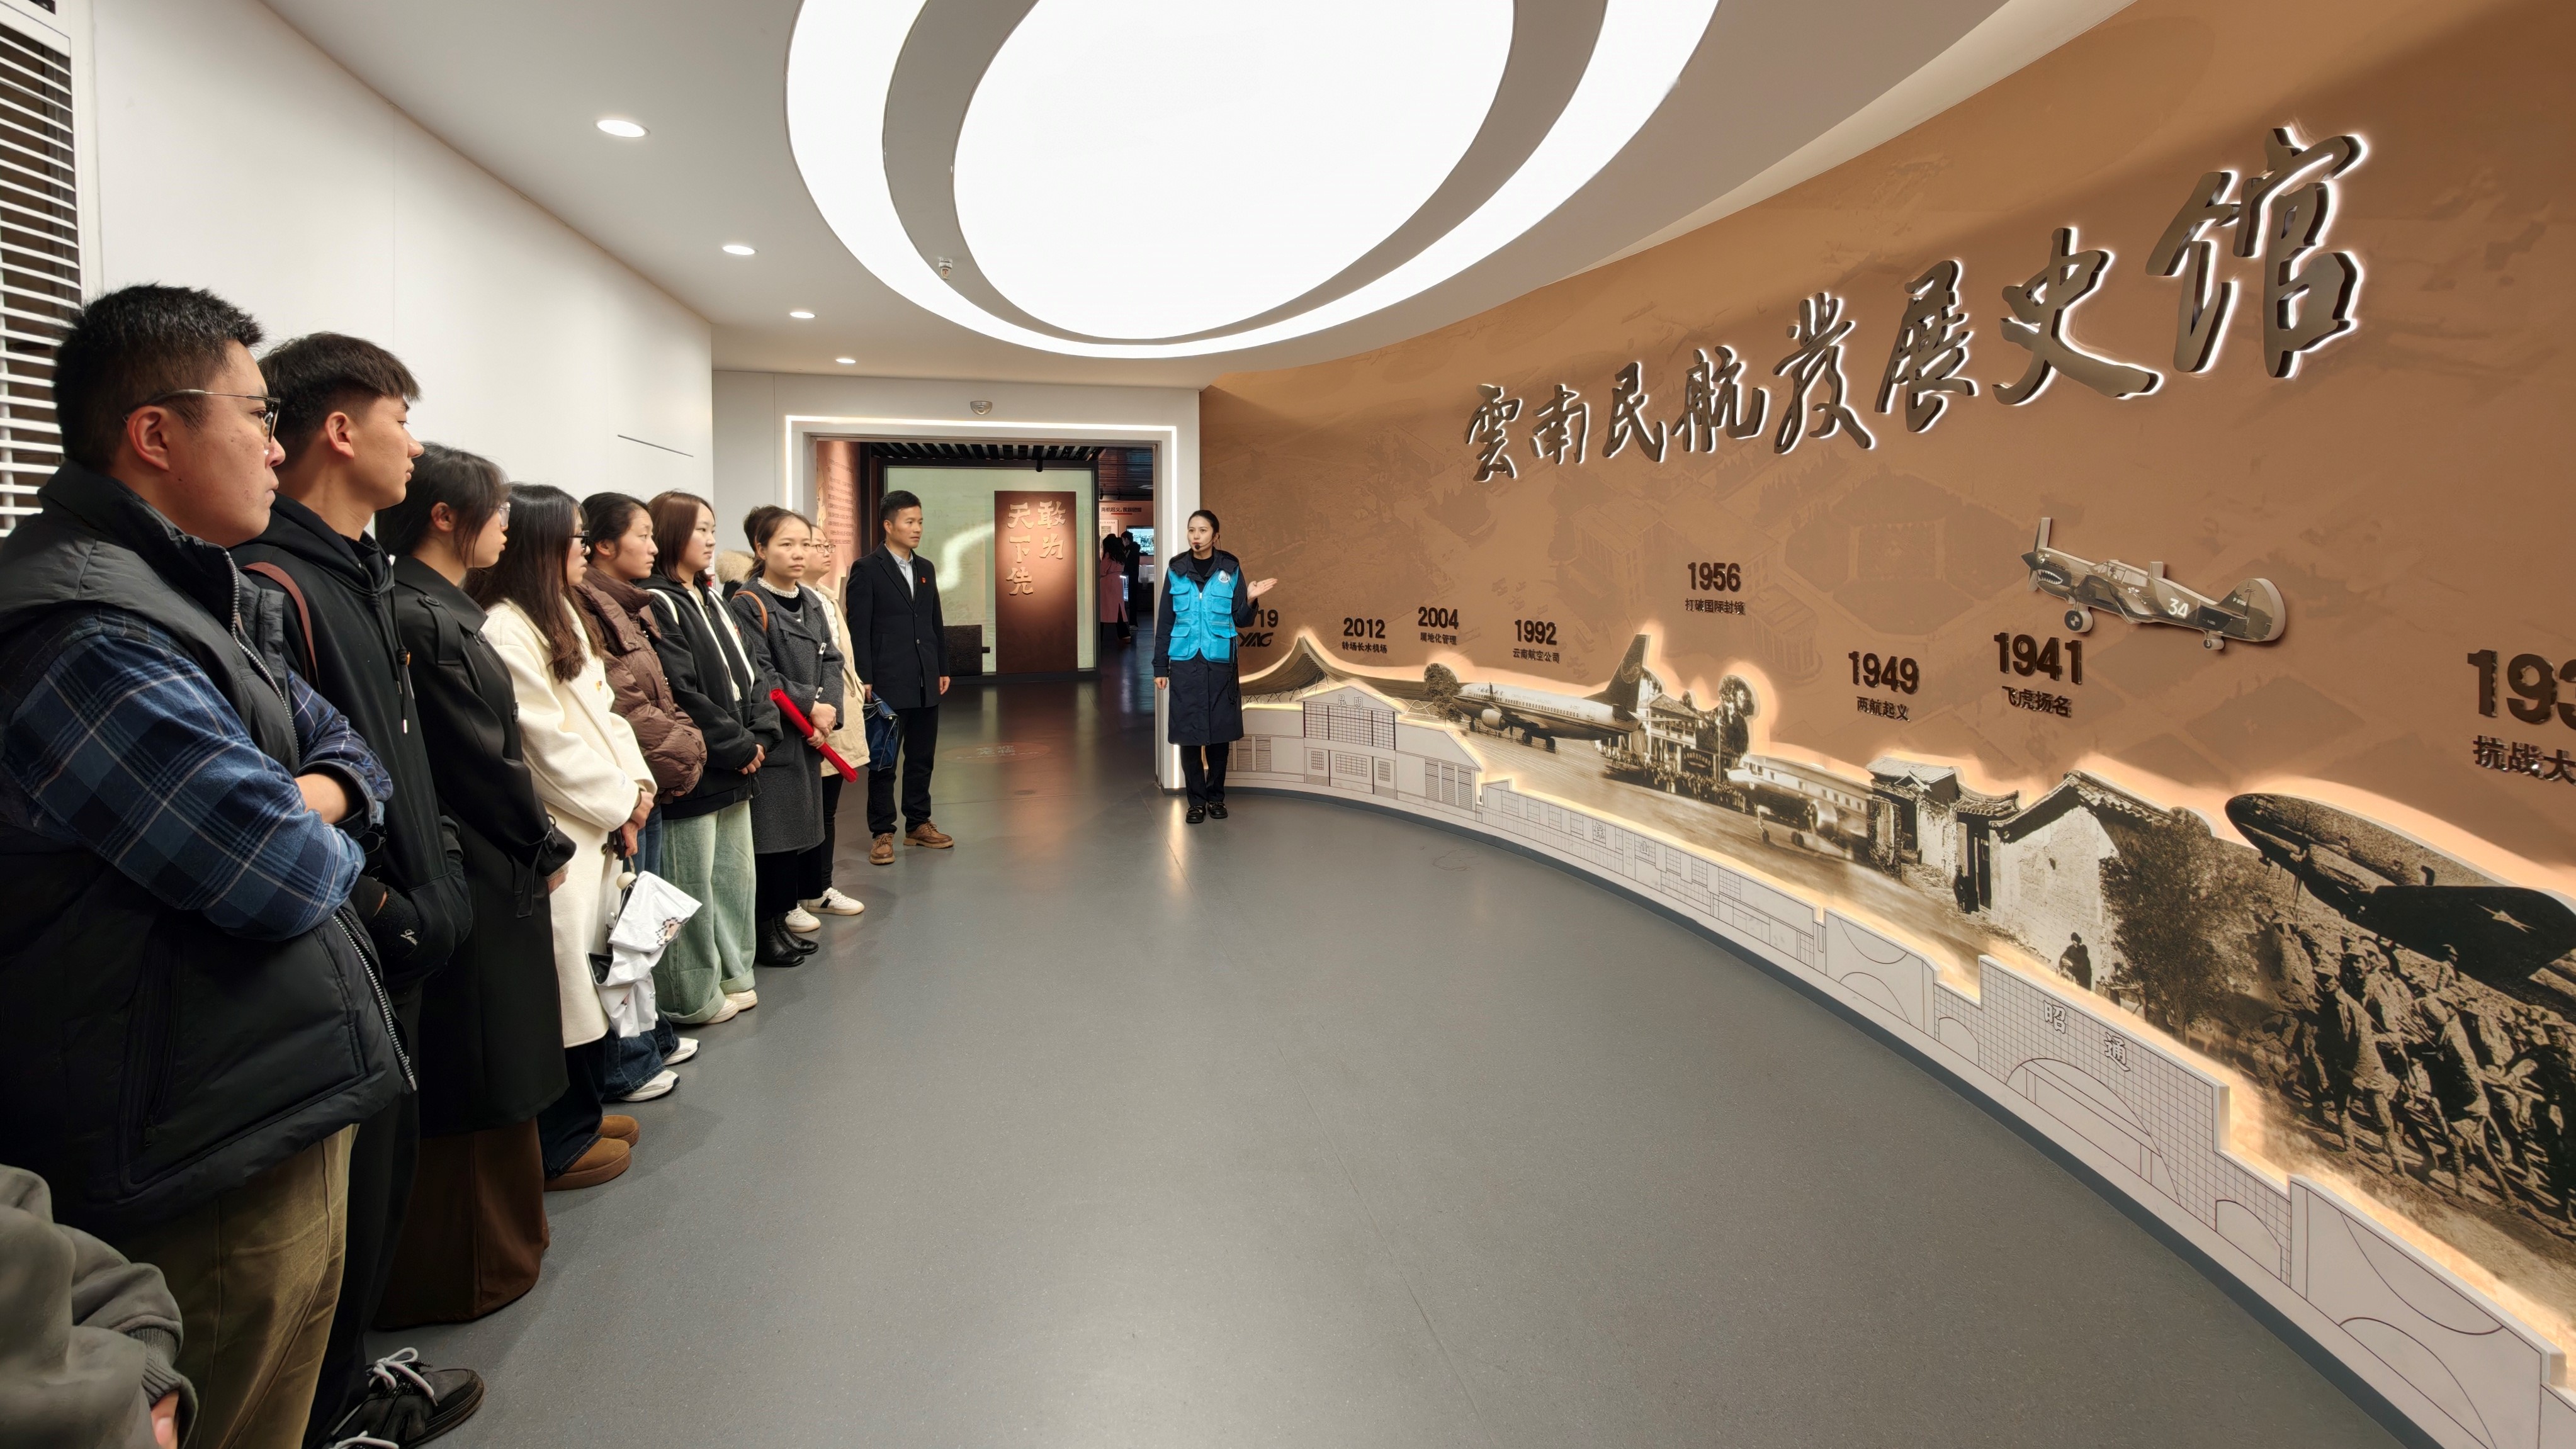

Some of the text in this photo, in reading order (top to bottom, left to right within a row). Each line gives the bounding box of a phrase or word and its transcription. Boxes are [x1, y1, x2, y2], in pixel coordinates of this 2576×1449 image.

[1037, 500, 1066, 560] 敢为
[1006, 502, 1034, 595] 天下先
[1688, 562, 1741, 592] 1956
[1257, 609, 1279, 628] 19
[1418, 606, 1459, 629] 2004
[1685, 598, 1746, 616] 打破国际封锁
[2168, 597, 2189, 619] 34
[1343, 617, 1386, 639] 2012
[1420, 632, 1457, 646] 属地化管理
[1515, 619, 1557, 645] 1992
[1342, 641, 1387, 654] 转场长水机场
[1513, 648, 1560, 664] 云南航空公司
[1994, 632, 2083, 685] 1941
[1848, 651, 1919, 695] 1949
[1338, 694, 1363, 709] 昆明
[1856, 696, 1911, 722] 两航起义
[2002, 685, 2072, 718] 飞虎扬名
[2043, 1000, 2130, 1071] 昭通
